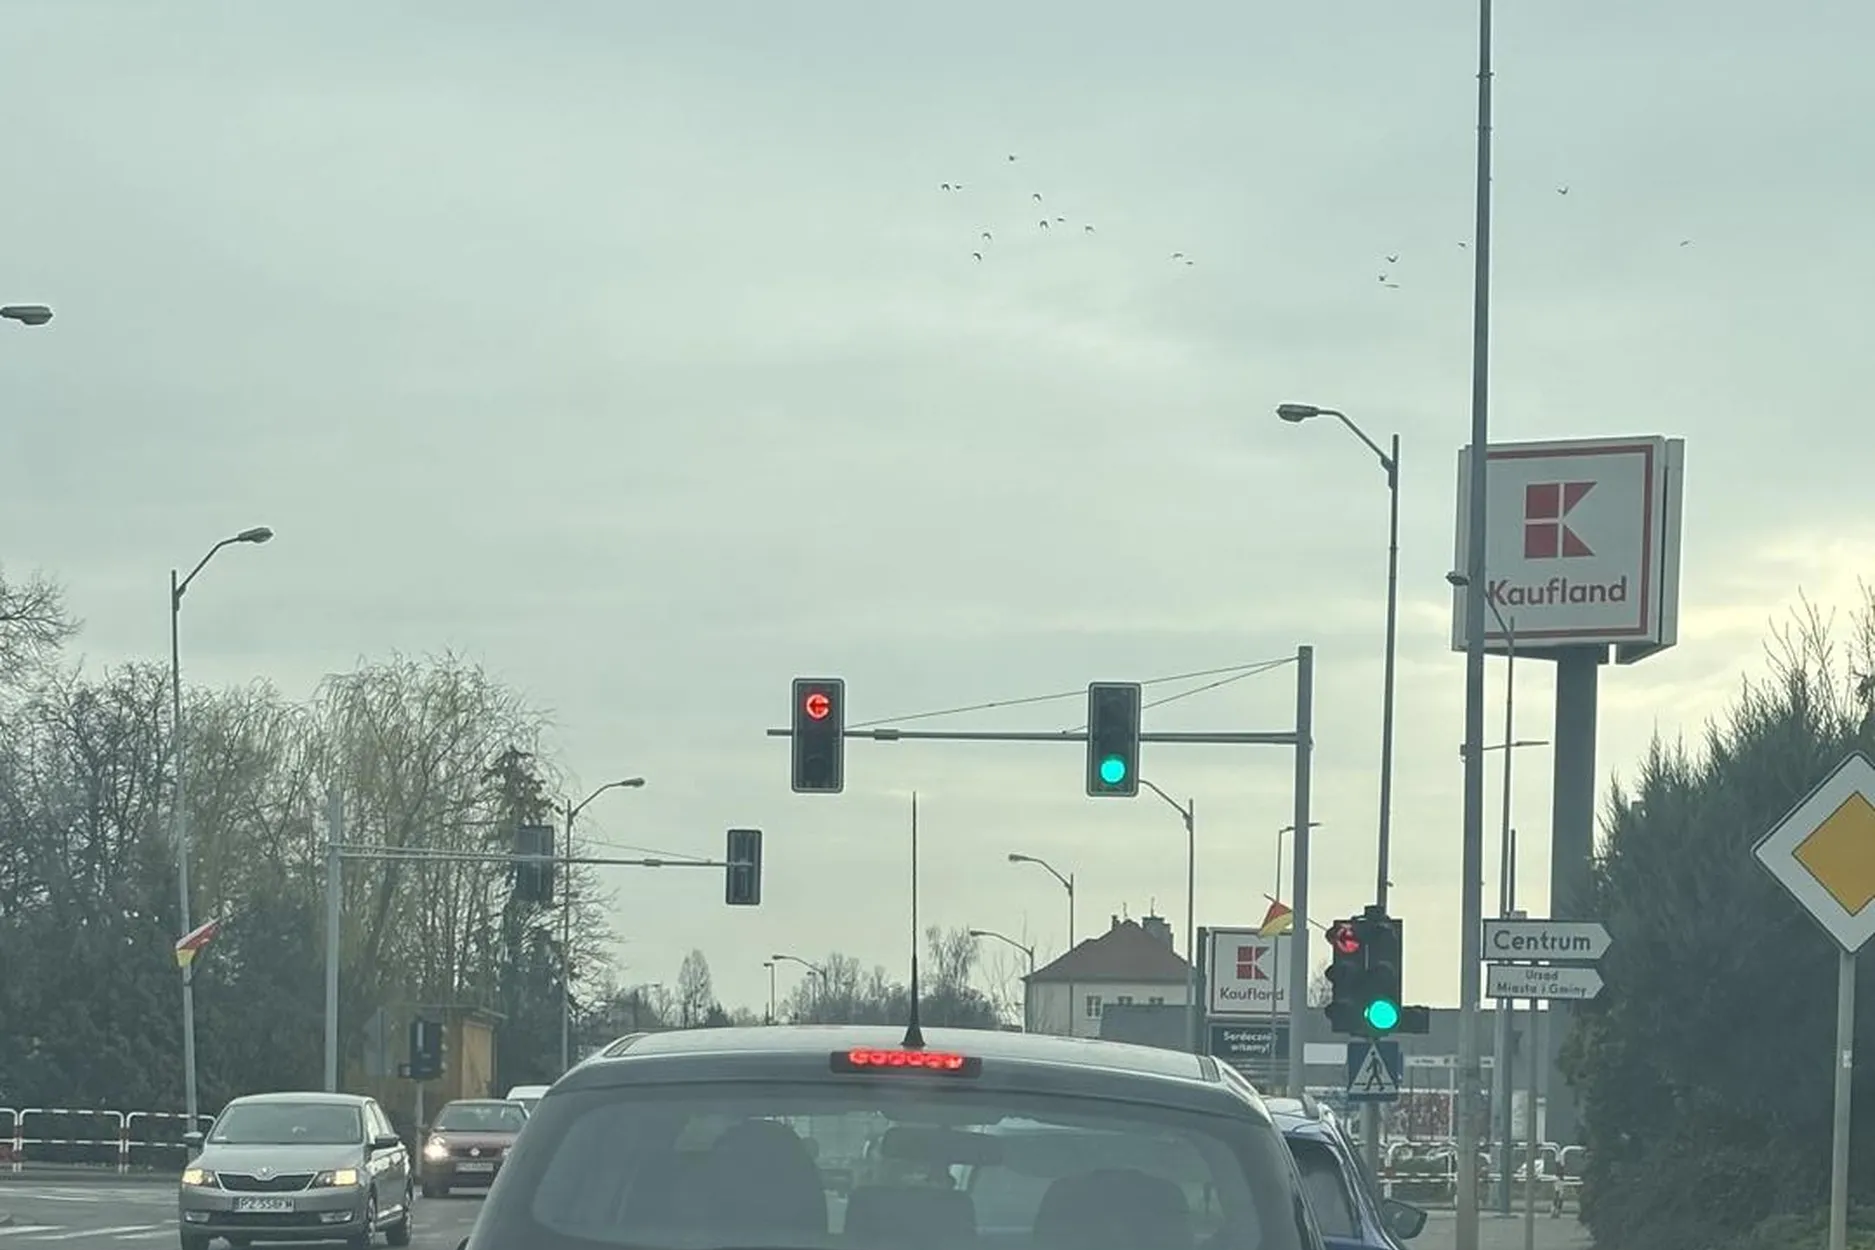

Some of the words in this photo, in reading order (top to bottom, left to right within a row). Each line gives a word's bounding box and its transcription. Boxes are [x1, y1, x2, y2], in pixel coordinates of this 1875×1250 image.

[1488, 576, 1627, 606] Kaufland
[1493, 930, 1591, 951] Centrum
[1220, 987, 1285, 1001] Kaufland
